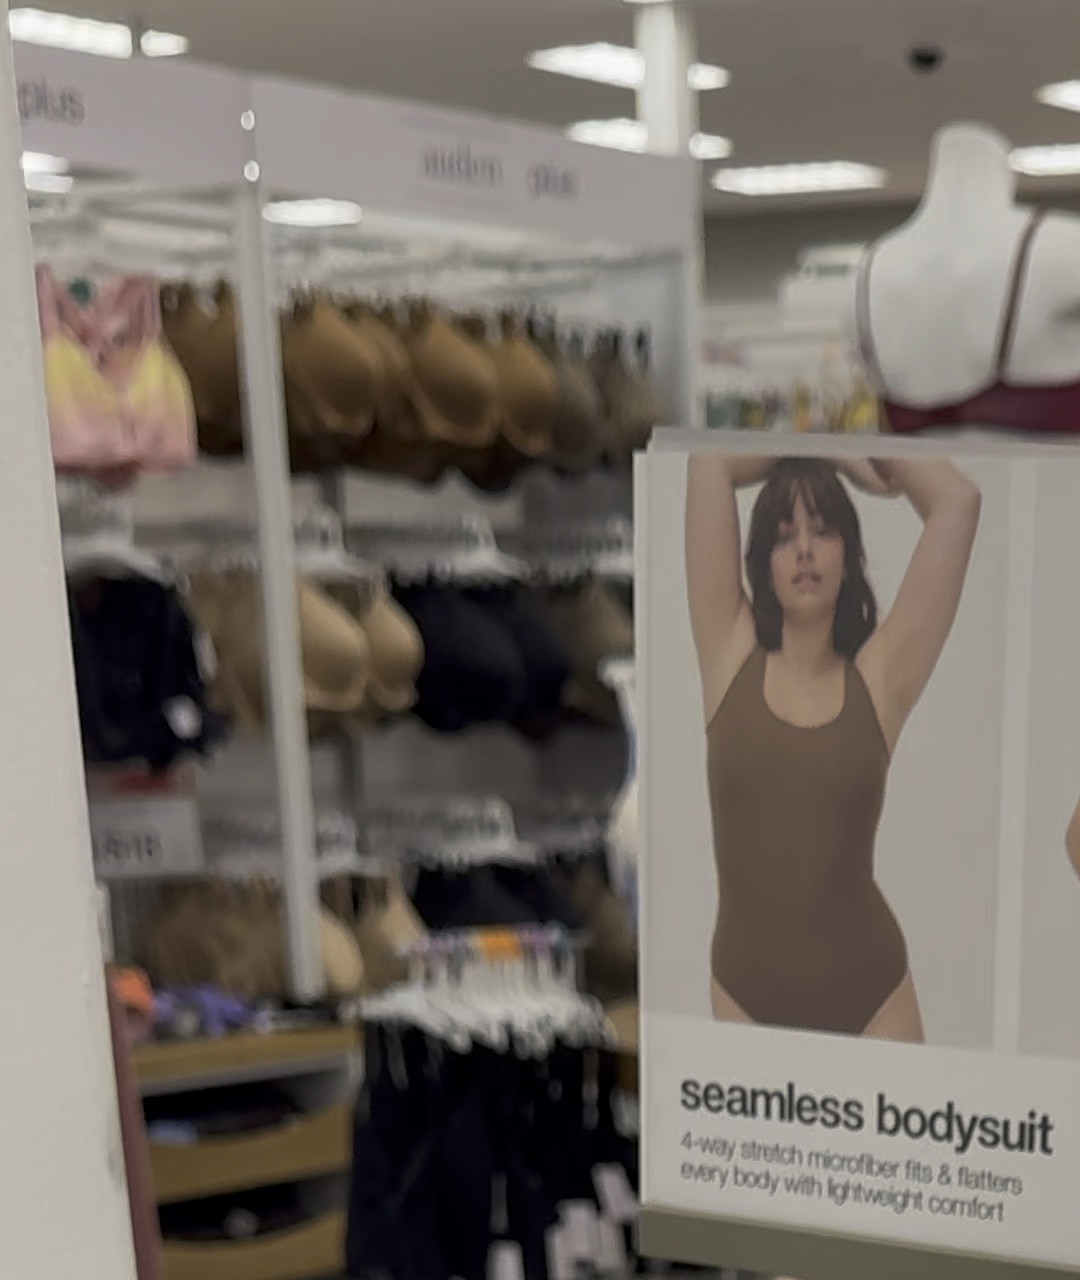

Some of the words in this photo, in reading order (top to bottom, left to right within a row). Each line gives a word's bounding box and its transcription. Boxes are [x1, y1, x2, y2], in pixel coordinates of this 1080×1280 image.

[680, 1078, 865, 1132] seamless
[877, 1093, 1055, 1156] bodysuit
[680, 1131, 737, 1160] 4-way
[740, 1141, 804, 1166] stretch
[807, 1150, 900, 1179] microfiber
[904, 1157, 934, 1183] fits
[937, 1167, 952, 1186] &
[957, 1167, 1024, 1197] flatters
[680, 1160, 730, 1189] every
[732, 1166, 781, 1195] body
[783, 1175, 823, 1199] with
[826, 1179, 924, 1212] lightweight
[929, 1197, 1006, 1223] comfort
